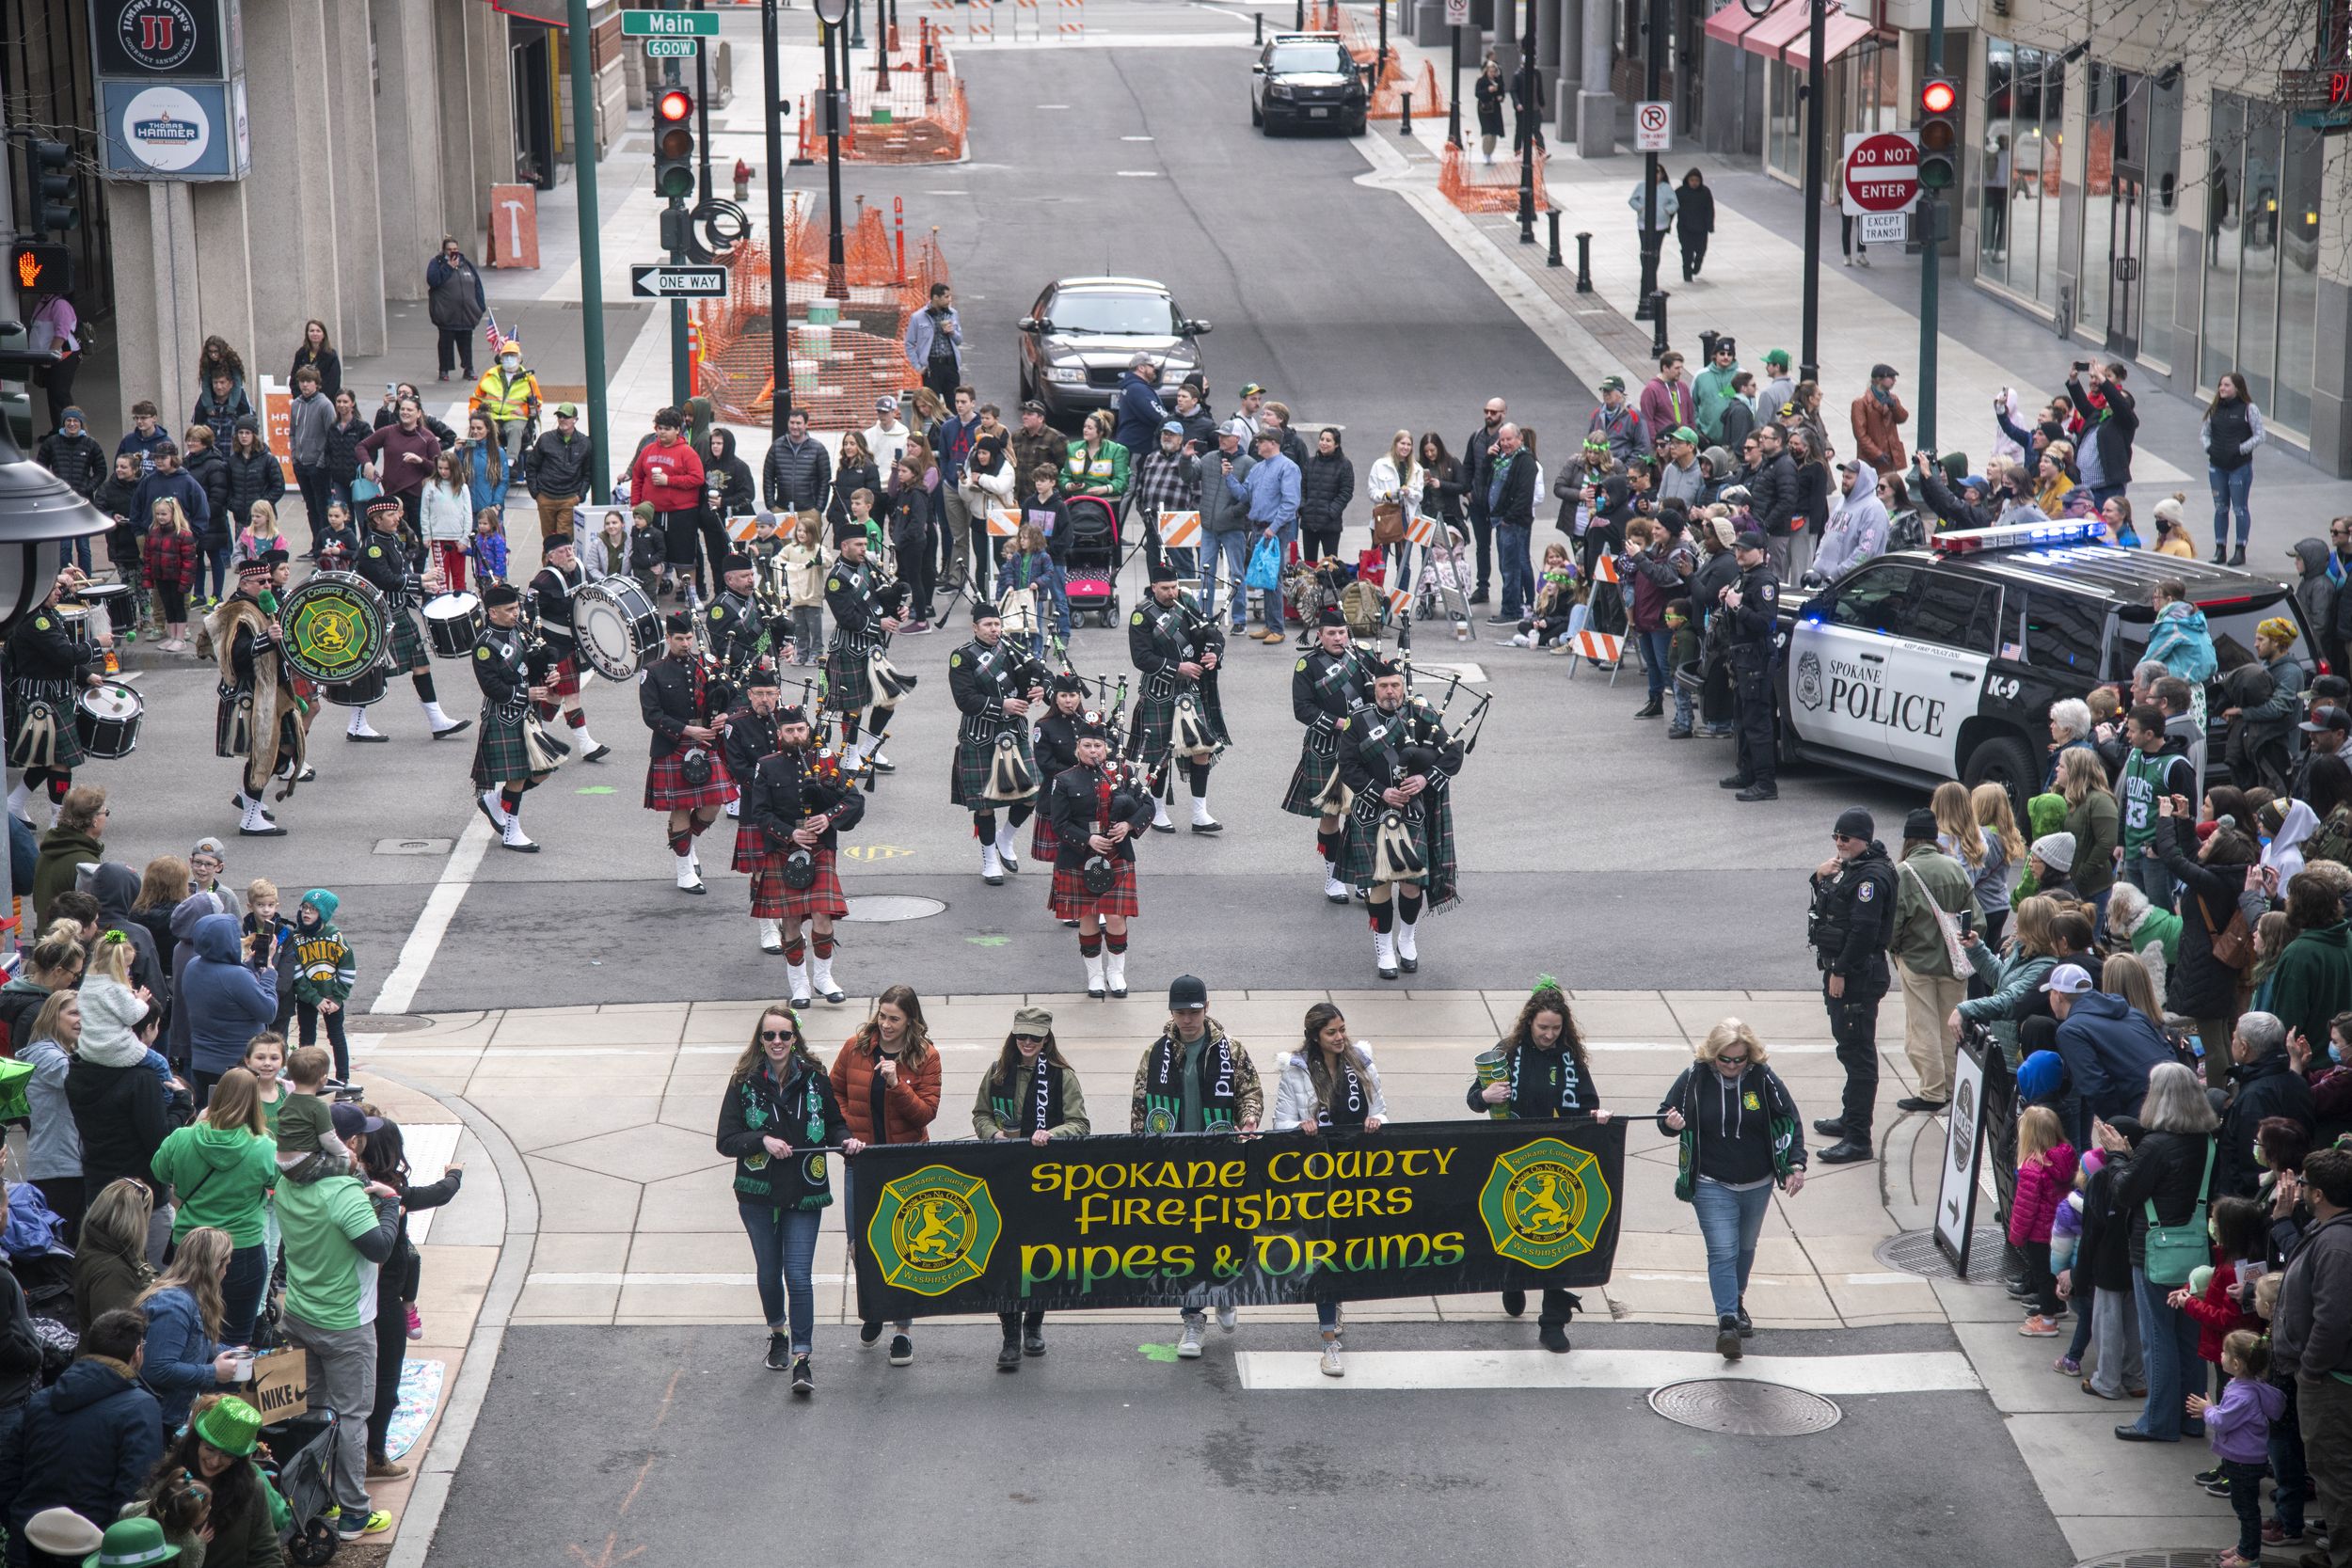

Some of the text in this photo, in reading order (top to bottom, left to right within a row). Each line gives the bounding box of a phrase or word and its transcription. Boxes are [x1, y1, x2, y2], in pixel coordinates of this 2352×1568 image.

[123, 0, 191, 32] JIMMY JOHN'S
[649, 14, 694, 32] Main
[140, 16, 174, 50] JJ
[125, 37, 190, 64] GOURMET SANDWICHES
[652, 41, 691, 55] 600W
[137, 128, 195, 138] HAMMER
[1857, 149, 1912, 163] DO NOT
[1861, 184, 1905, 198] ENTER
[1867, 215, 1899, 227] EXCEPT
[1867, 228, 1901, 239] TRANSIT
[660, 276, 716, 288] ONE WAY
[1829, 659, 1882, 684] SPOKANE
[1988, 674, 2020, 700] K-9
[1828, 677, 1946, 738] POLICE
[2127, 776, 2153, 803] CELTICS
[2126, 798, 2148, 829] 33
[1031, 1147, 1458, 1201] SPOKANE COUNTY
[1075, 1186, 1413, 1235] FIREFIGHTERS
[1020, 1230, 1466, 1298] PIPES & DRUMS
[261, 1384, 294, 1411] NIKE
